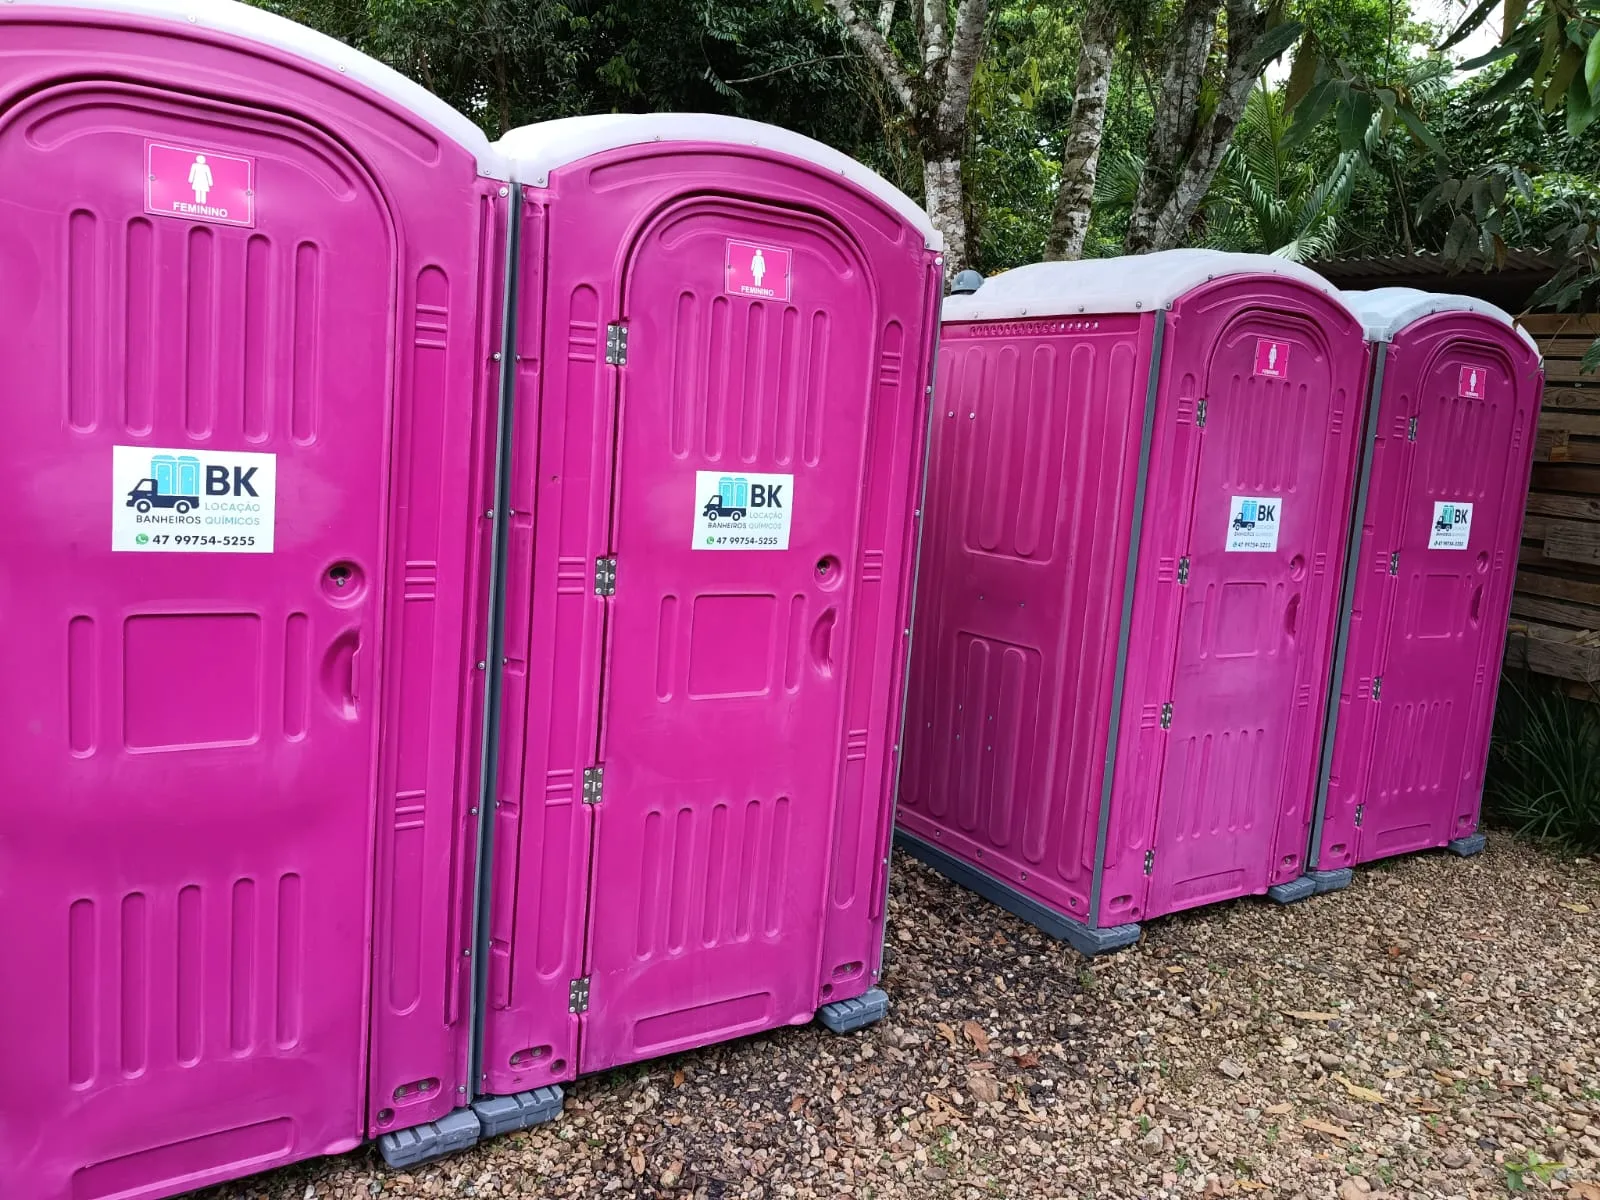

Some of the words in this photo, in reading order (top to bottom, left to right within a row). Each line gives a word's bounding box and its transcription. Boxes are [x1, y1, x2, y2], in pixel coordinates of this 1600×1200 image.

[173, 201, 228, 217] FEMININO
[741, 285, 774, 296] FEMININO
[205, 465, 260, 497] BK
[751, 484, 783, 508] BK
[204, 501, 260, 513] LOCAÇÃO
[1257, 505, 1276, 521] BK
[136, 514, 201, 525] BANHEIROS
[205, 515, 260, 526] QUÍMICOS
[749, 511, 783, 520] LOCAÇÃO
[1454, 509, 1468, 524] BK
[152, 535, 170, 545] 47
[174, 535, 255, 546] 99754-5255
[716, 537, 727, 545] 47
[729, 537, 778, 545] 99754-5255
